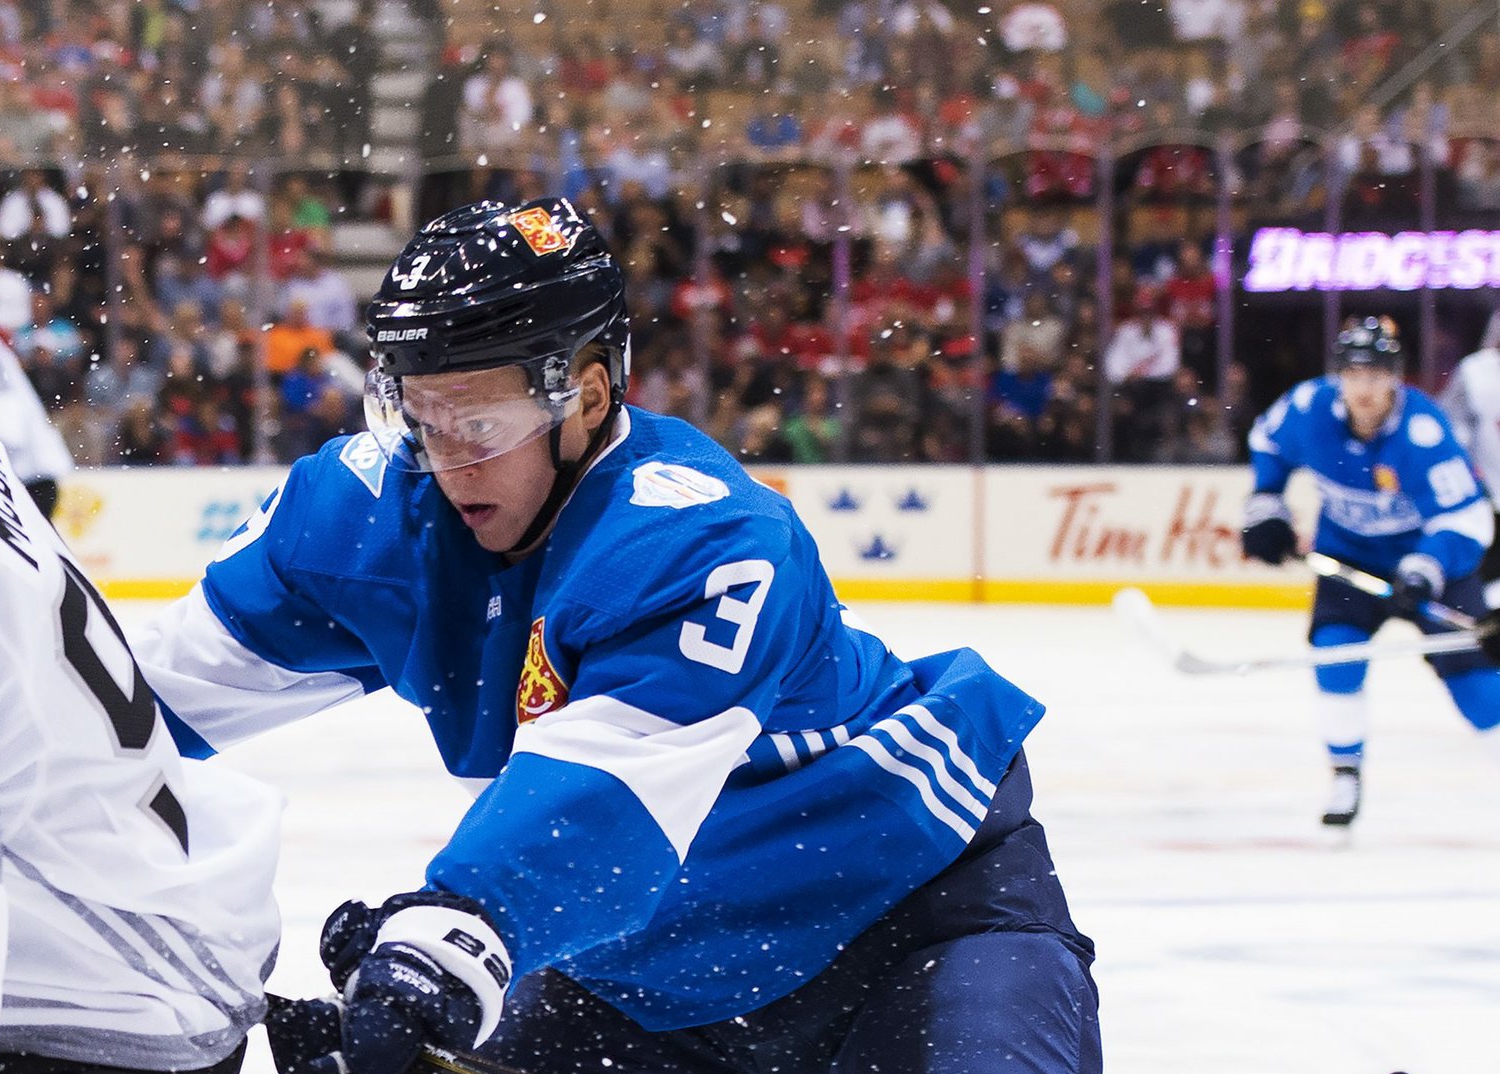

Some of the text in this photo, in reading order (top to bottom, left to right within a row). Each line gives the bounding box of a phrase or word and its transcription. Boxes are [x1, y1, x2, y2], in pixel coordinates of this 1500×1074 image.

[376, 326, 429, 343] BAUER
[1046, 480, 1149, 565] Tim
[679, 559, 776, 675] 3
